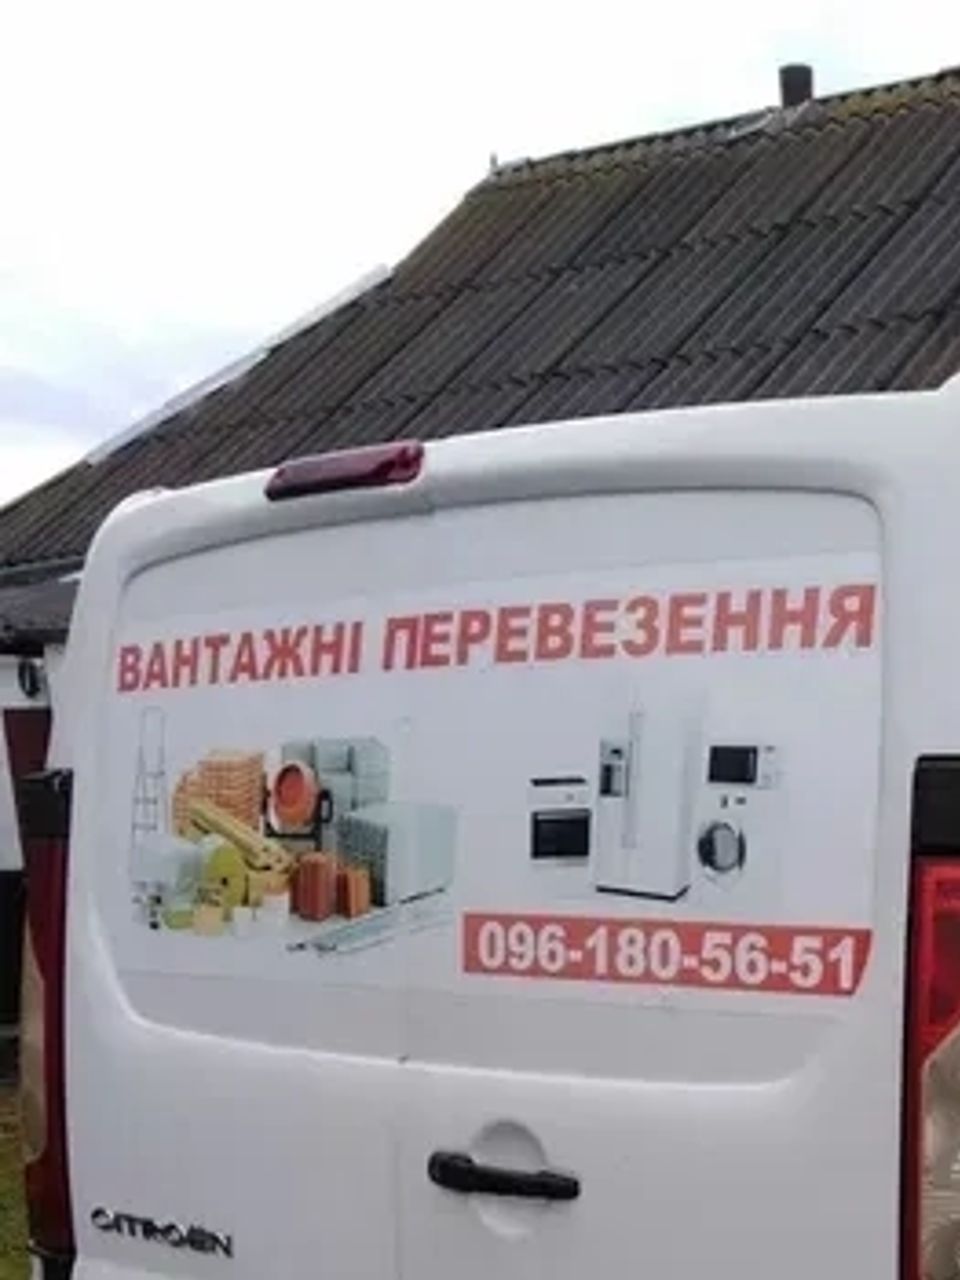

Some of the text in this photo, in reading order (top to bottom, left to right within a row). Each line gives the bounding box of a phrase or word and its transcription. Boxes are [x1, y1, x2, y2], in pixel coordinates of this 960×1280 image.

[117, 585, 877, 692] ВАНТАЖНІ ПЕРЕВЕЗЕННЯ
[478, 920, 858, 991] 096-180-56-51
